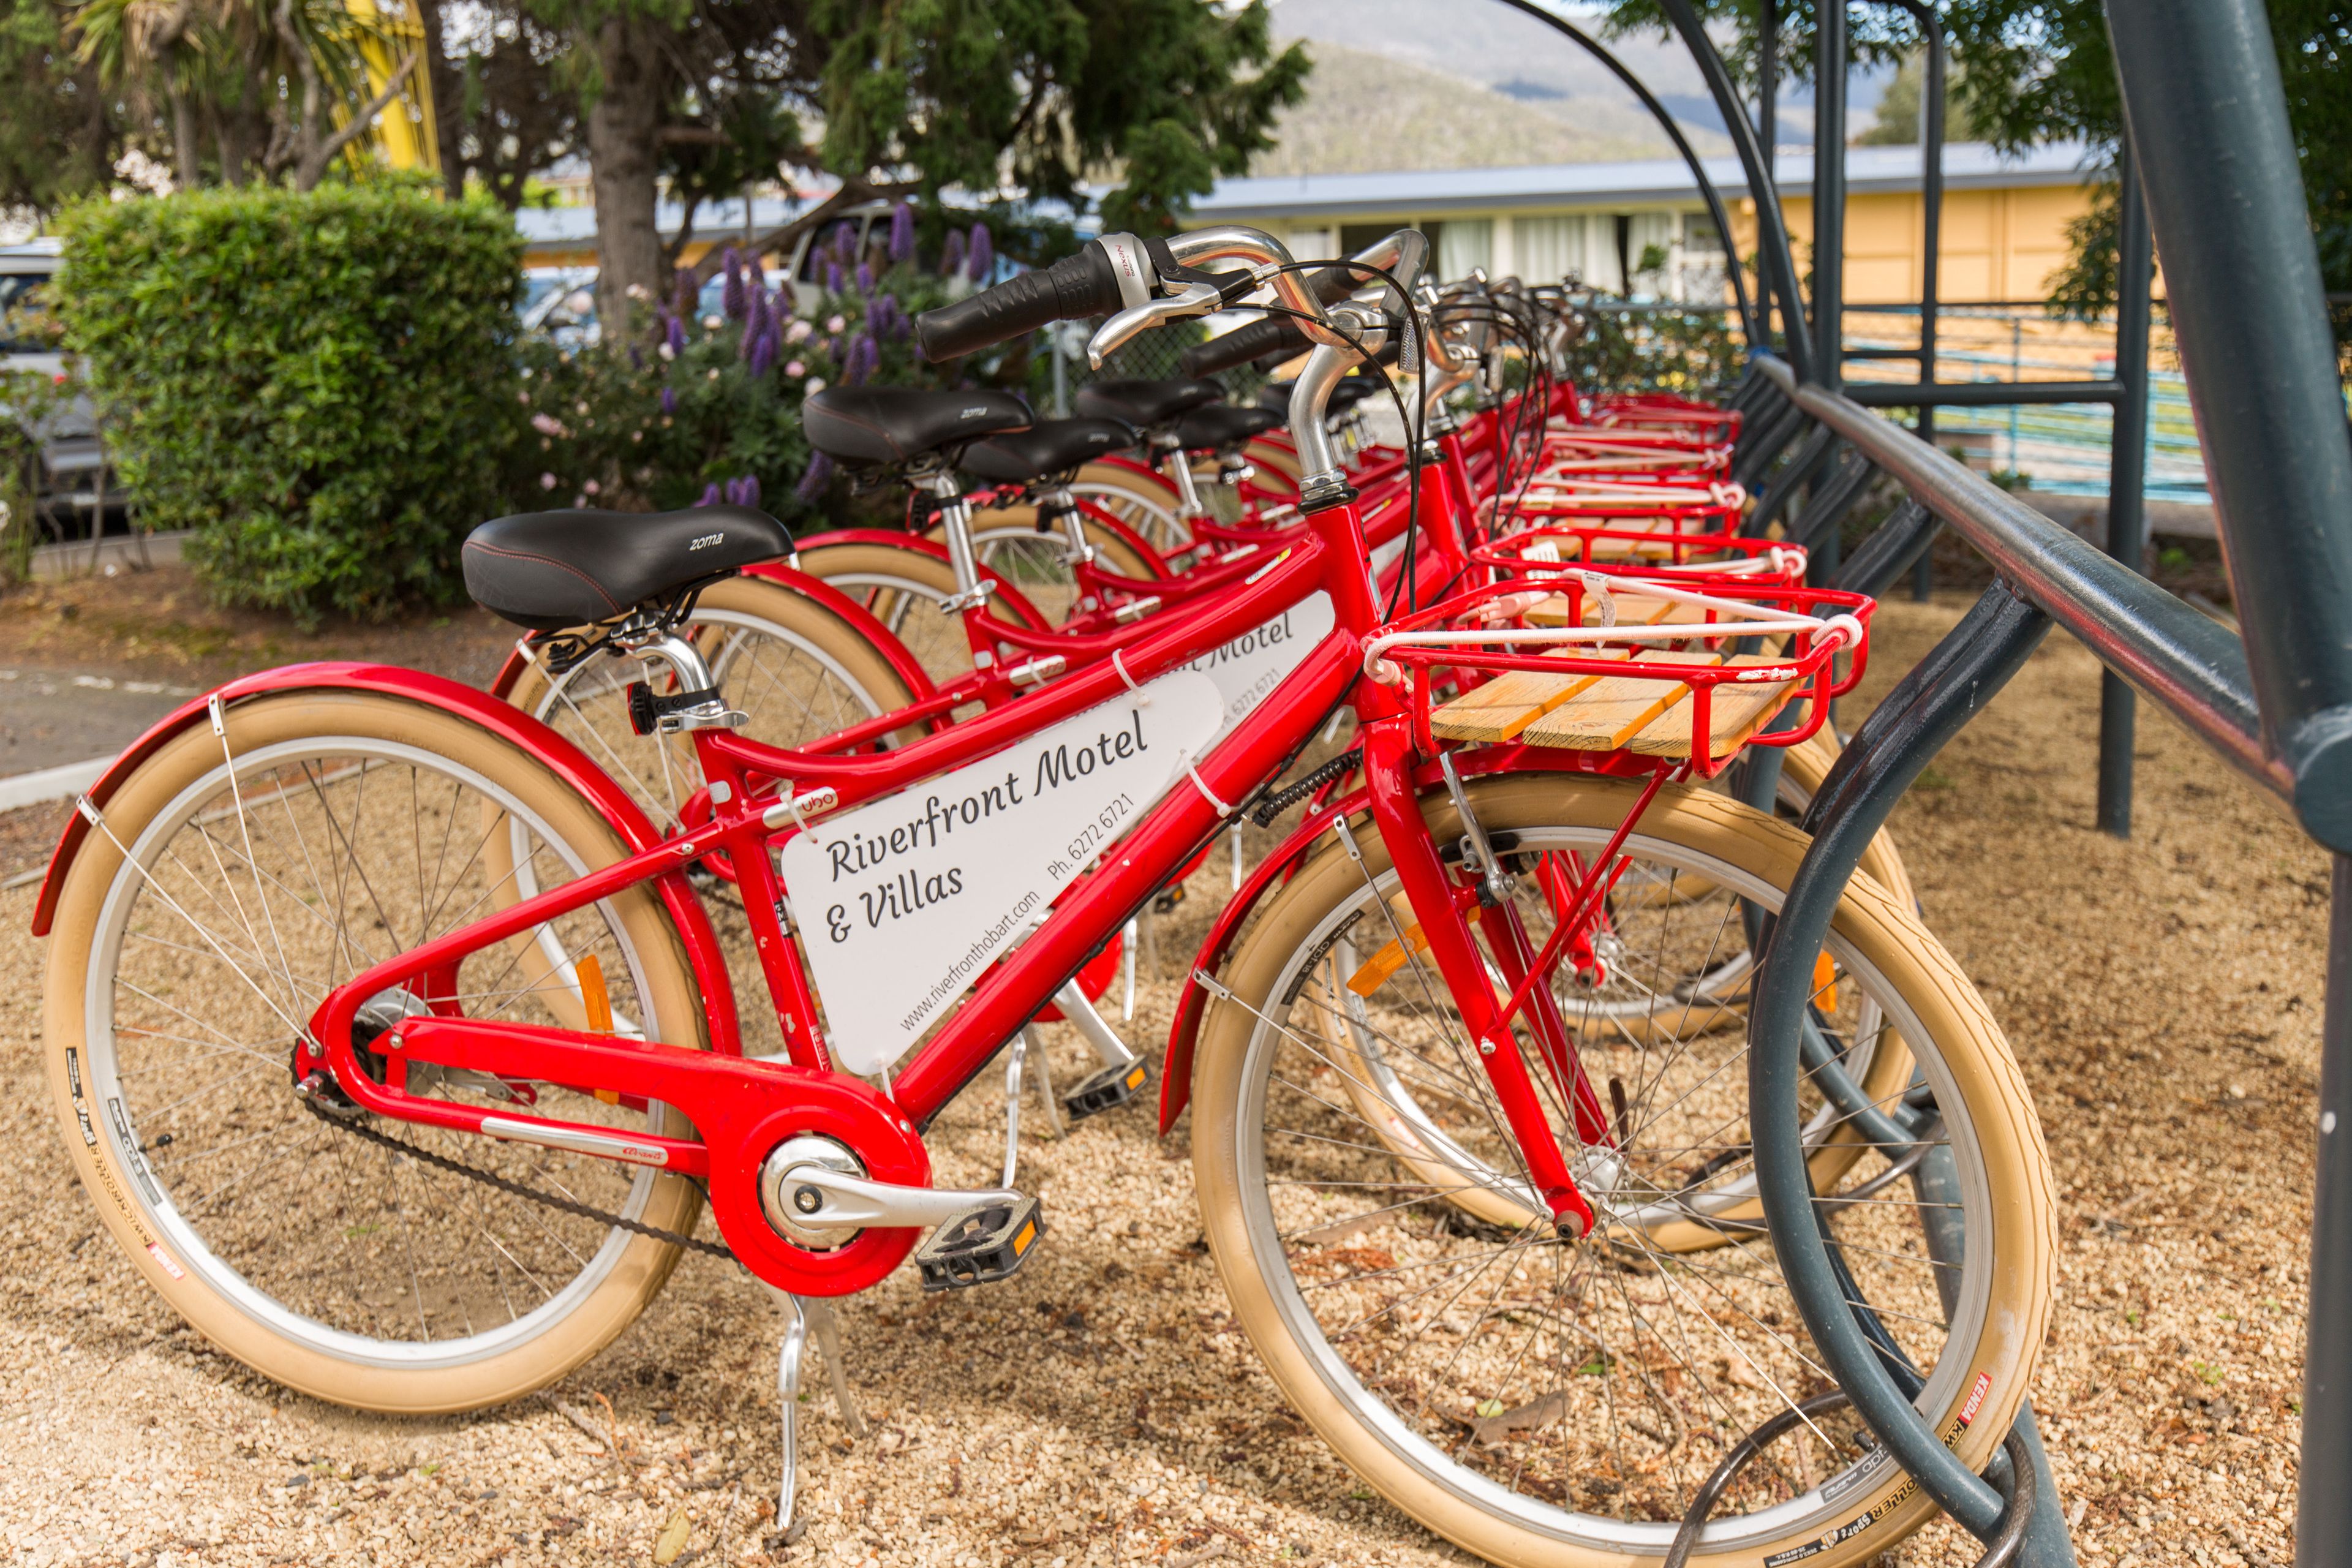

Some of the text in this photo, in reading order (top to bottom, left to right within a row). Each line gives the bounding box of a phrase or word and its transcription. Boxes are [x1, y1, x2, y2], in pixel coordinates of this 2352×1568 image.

[689, 532, 724, 551] zoma
[1256, 668, 1281, 695] 6721
[826, 710, 1148, 882] Riverfront Motel
[1047, 793, 1134, 881] Ph. 6272 6721
[827, 905, 851, 943] &
[860, 867, 962, 928] Villas
[900, 890, 1040, 1031] www.riverfronthobart.com
[1961, 1374, 1989, 1421] KENDA
[1862, 1449, 1888, 1472] apt-
[1872, 1479, 1917, 1518] OLLER
